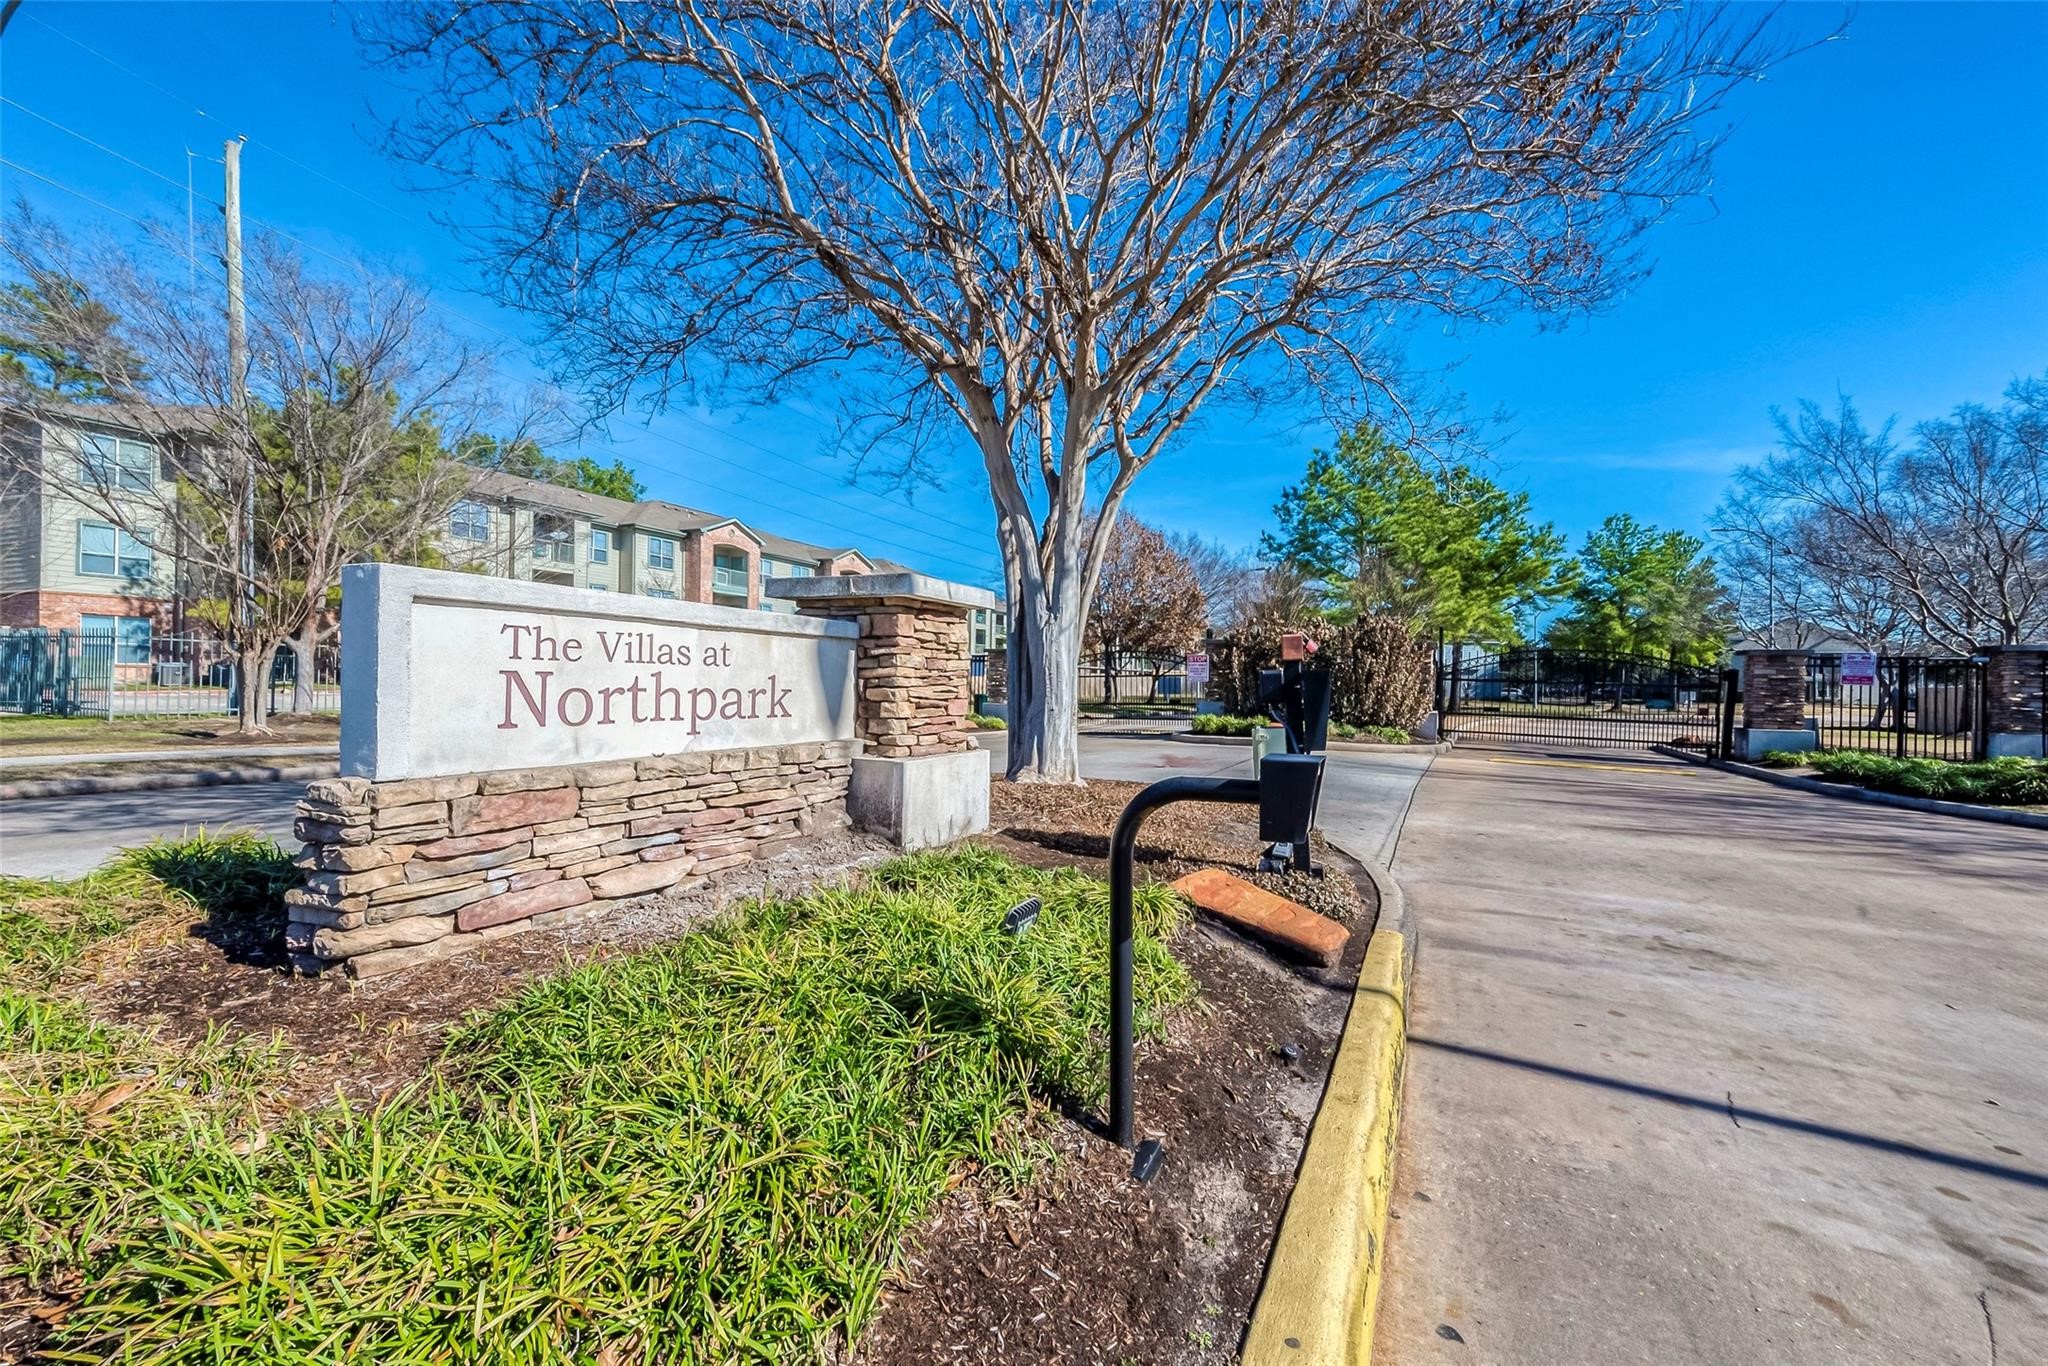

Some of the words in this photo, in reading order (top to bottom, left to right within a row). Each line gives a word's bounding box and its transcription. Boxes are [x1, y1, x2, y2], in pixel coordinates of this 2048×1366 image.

[499, 623, 583, 662] The
[596, 631, 691, 666] Villas
[702, 641, 732, 667] at
[497, 669, 793, 736] Northpark
